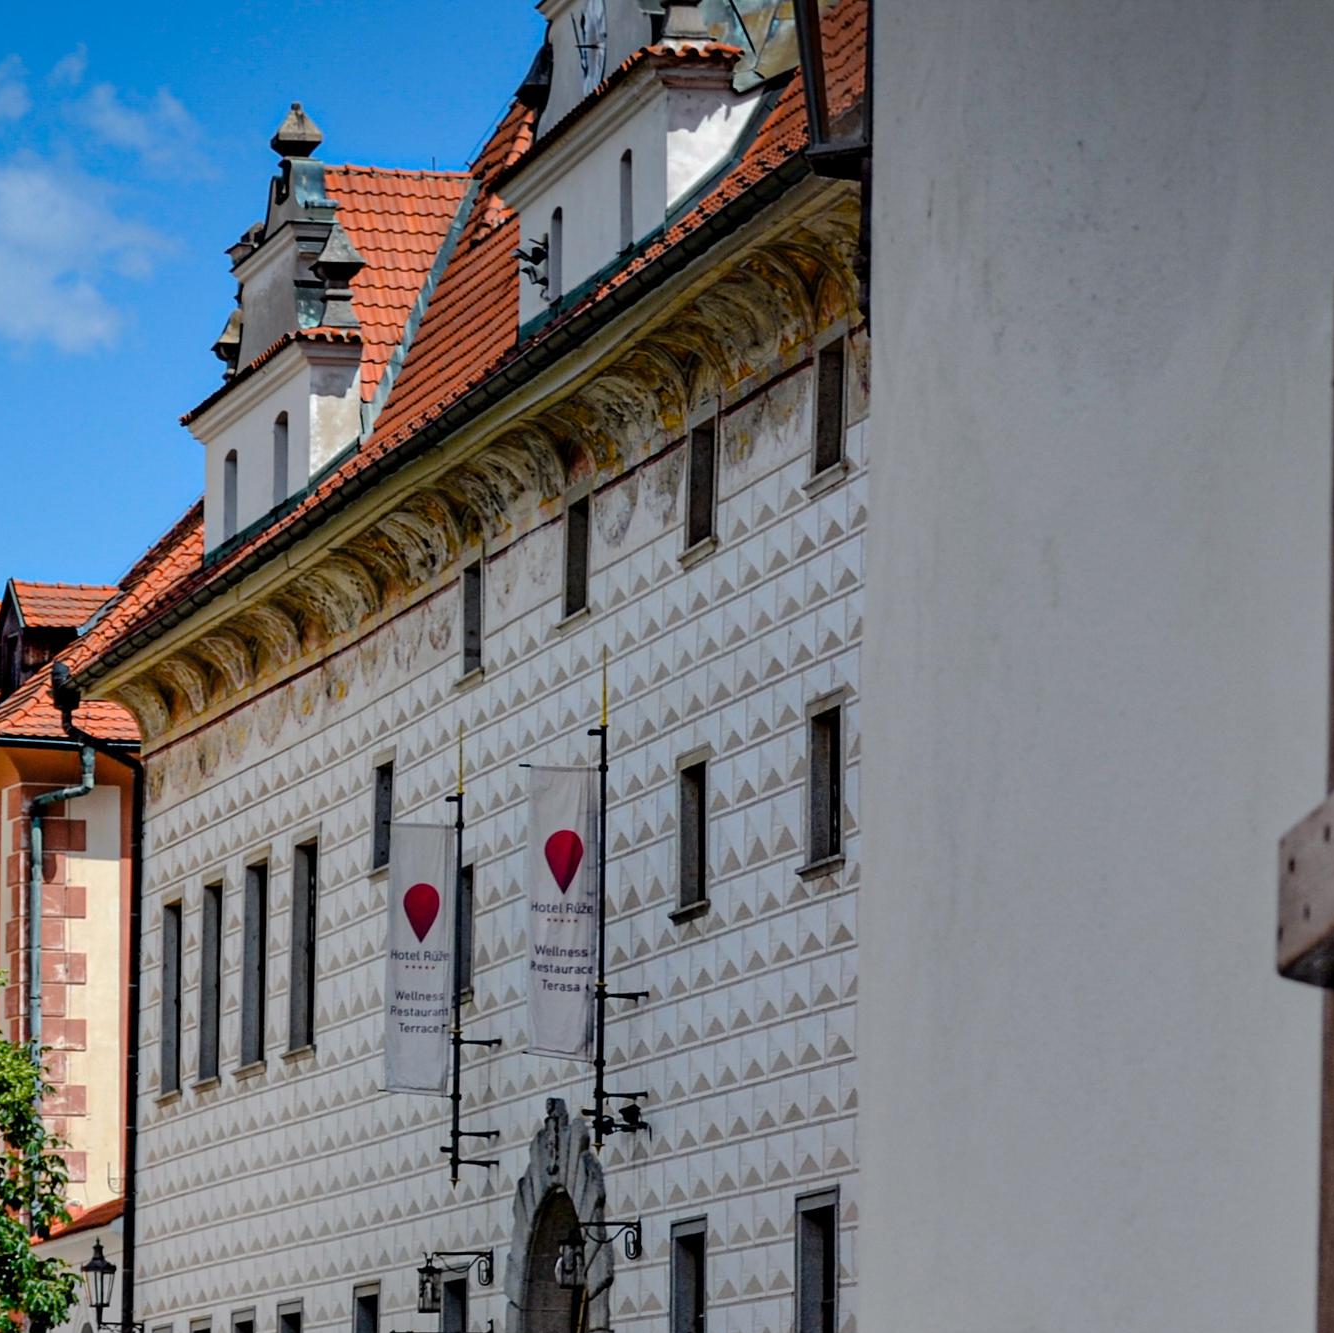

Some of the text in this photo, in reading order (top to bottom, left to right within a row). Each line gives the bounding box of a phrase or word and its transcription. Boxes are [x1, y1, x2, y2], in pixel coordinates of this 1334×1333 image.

[531, 901, 594, 914] Hotel Růže
[390, 949, 420, 961] Hotel
[534, 944, 589, 958] Wellness
[530, 960, 594, 975] Restaurace
[541, 979, 581, 992] Terasa
[395, 989, 445, 1002] Wellness
[389, 1005, 449, 1017] Restaurant
[398, 1022, 441, 1033] Terrace
